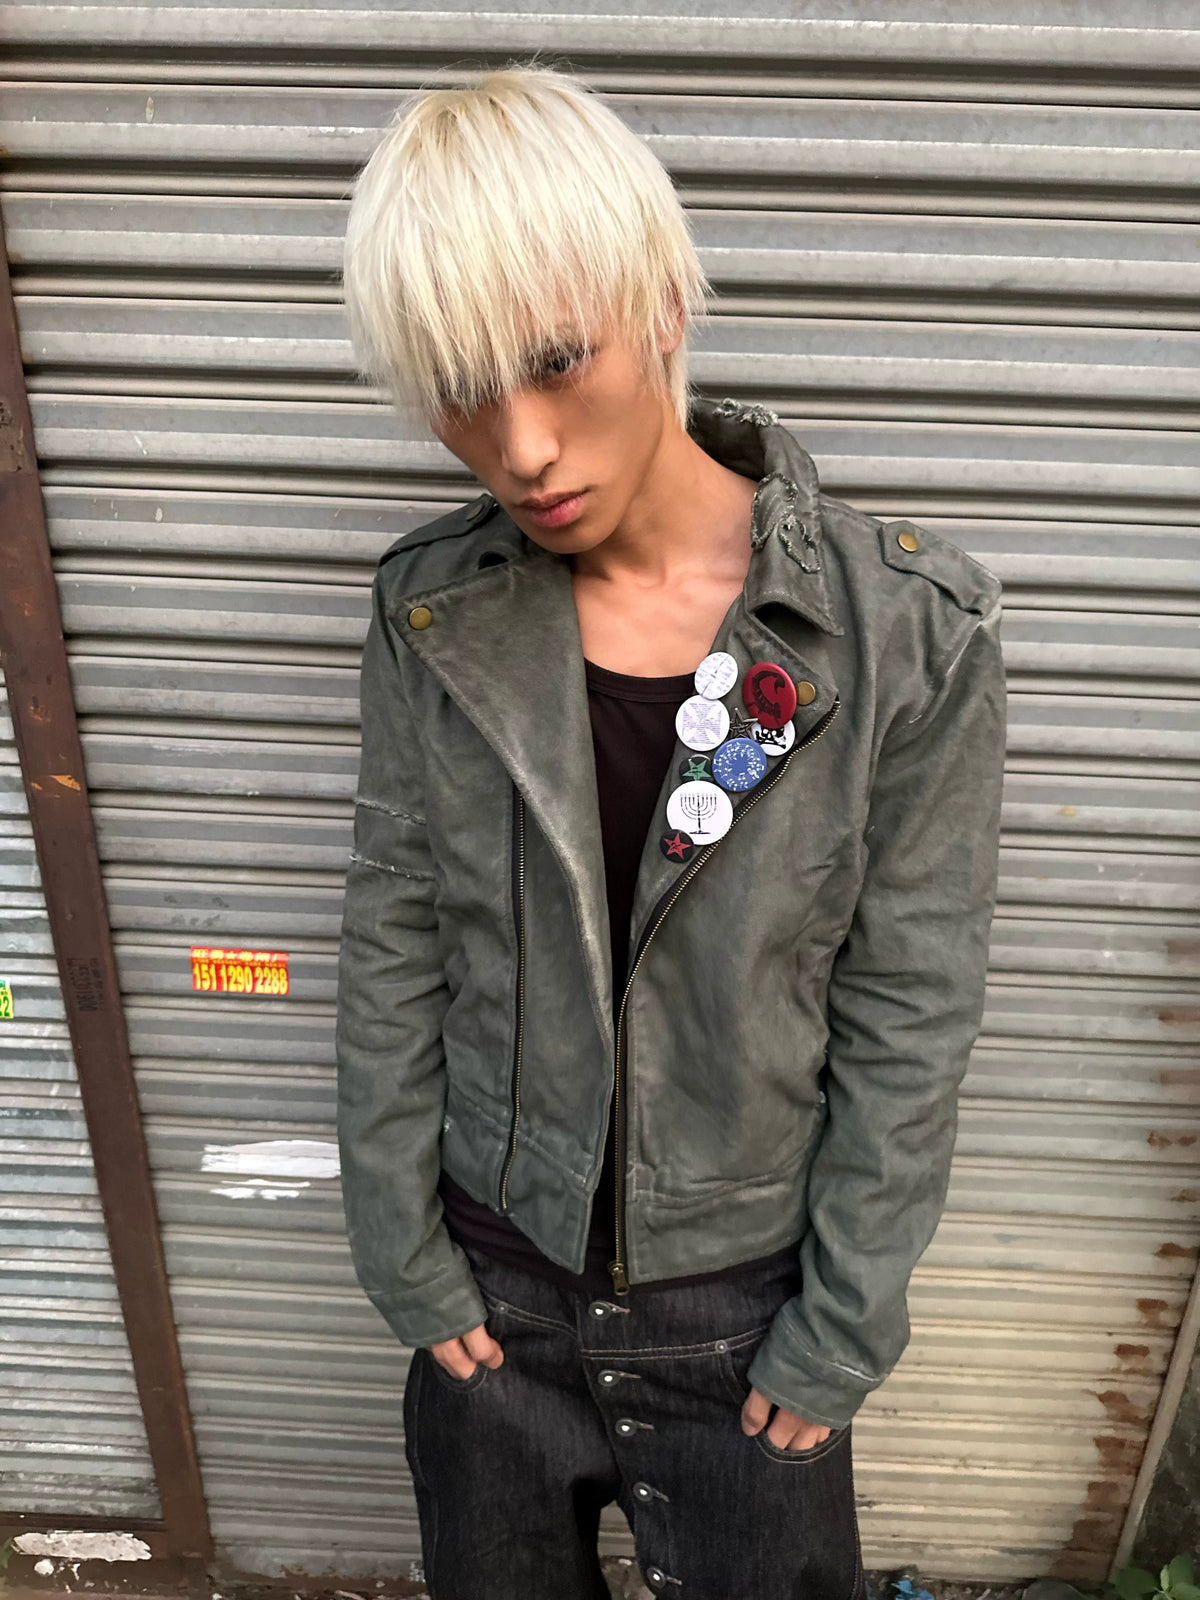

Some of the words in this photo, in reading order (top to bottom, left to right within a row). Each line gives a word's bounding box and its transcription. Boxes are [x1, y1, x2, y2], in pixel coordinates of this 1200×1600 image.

[194, 963, 217, 991] 151
[220, 964, 253, 993] 1290
[254, 966, 288, 995] 2288
